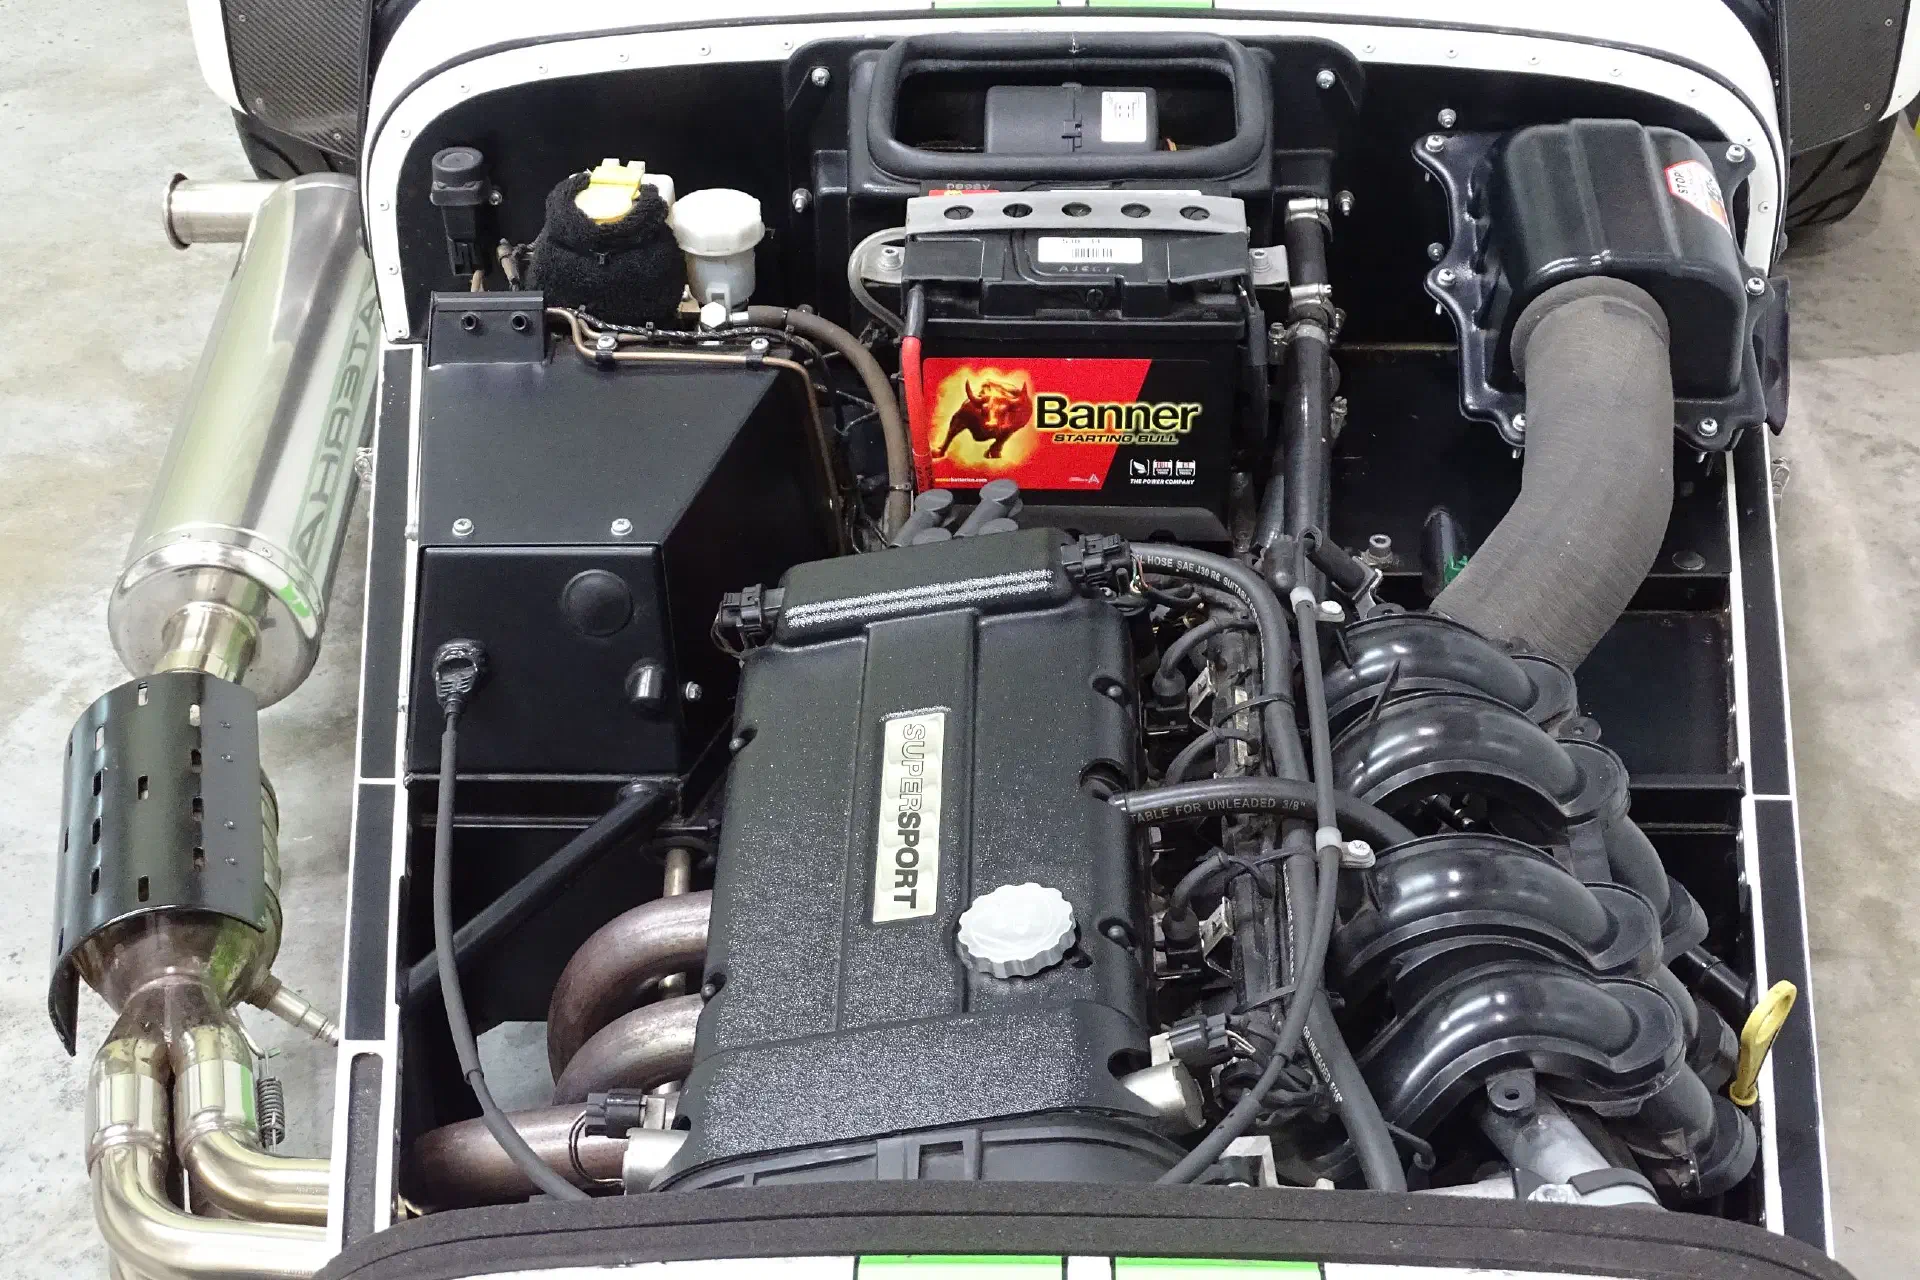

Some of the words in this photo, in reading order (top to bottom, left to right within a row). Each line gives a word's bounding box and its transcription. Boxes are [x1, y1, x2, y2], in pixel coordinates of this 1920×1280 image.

[1035, 394, 1201, 431] Banner
[1053, 433, 1133, 443] STARTING
[1137, 433, 1178, 443] BULL
[1147, 555, 1173, 567] HOSE
[1176, 560, 1195, 572] SAE
[1195, 565, 1210, 577] J30
[1210, 570, 1221, 582] R6
[893, 723, 926, 909] SUPERSPORT
[1175, 803, 1202, 816] FOR
[1208, 798, 1276, 811] UNLEADED
[1308, 1038, 1331, 1083] UNLEADED
